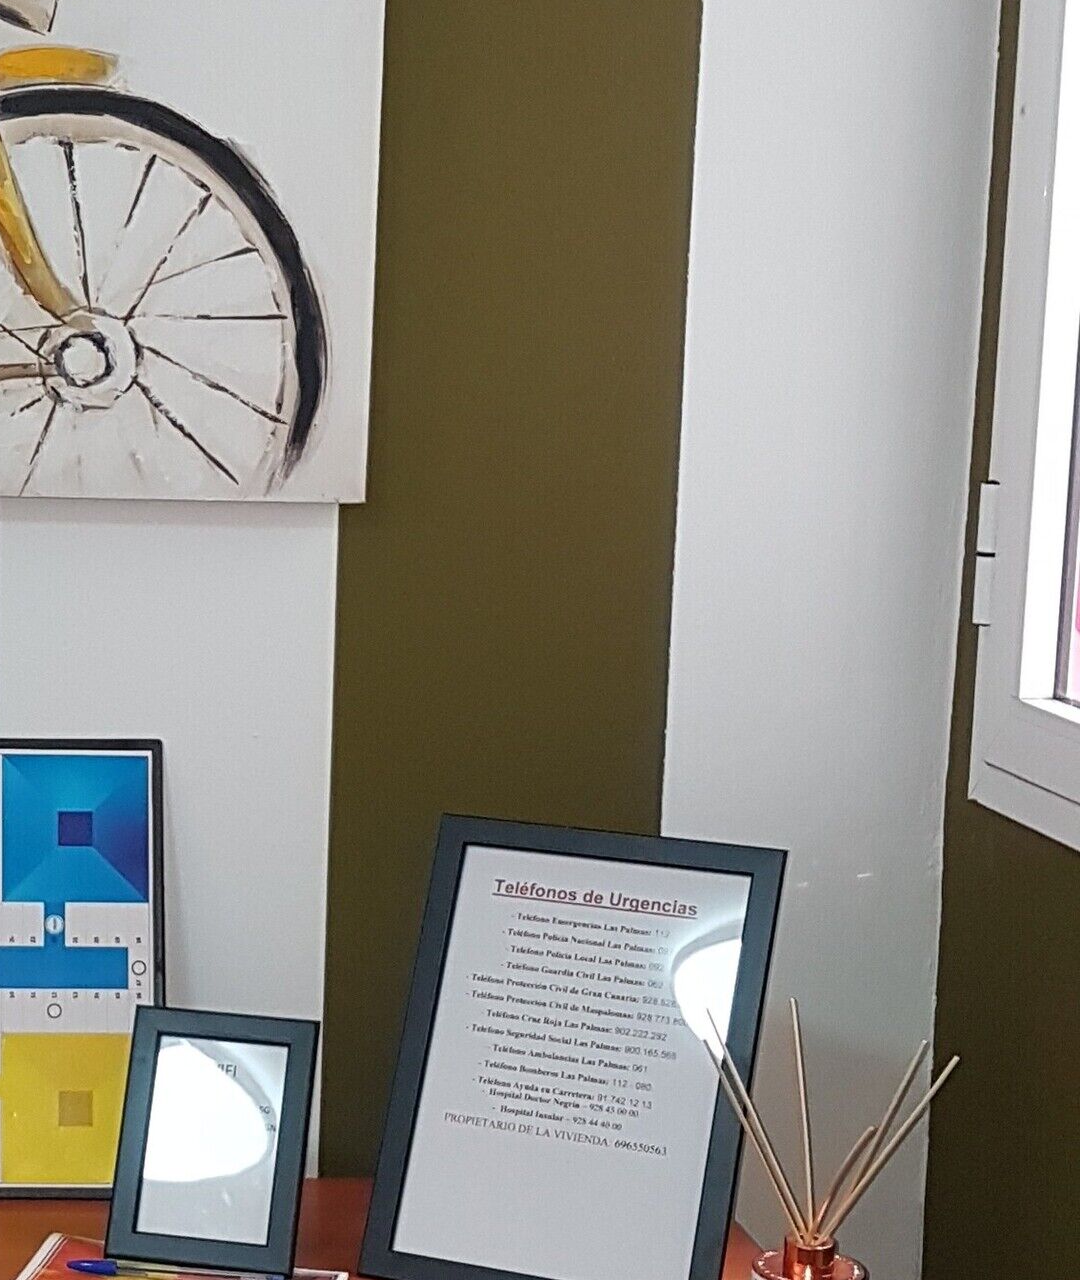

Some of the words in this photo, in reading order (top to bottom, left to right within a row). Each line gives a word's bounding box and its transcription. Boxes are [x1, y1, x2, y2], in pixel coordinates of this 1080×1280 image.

[494, 878, 577, 901] Teléfonos
[582, 889, 604, 904] de
[609, 891, 698, 916] Urgencias
[603, 923, 618, 932] Las
[607, 939, 622, 950] Las
[574, 953, 597, 964] Local
[598, 956, 613, 965] Las
[575, 970, 595, 980] Civil
[597, 972, 612, 982] Las
[548, 983, 568, 994] Civil
[569, 986, 579, 995] de
[581, 987, 603, 998] Gran
[548, 1000, 569, 1011] Civil
[569, 1004, 580, 1012] de
[542, 1016, 562, 1027] Roja
[564, 1019, 579, 1029] Las
[506, 1028, 547, 1041] Seguridad
[548, 1033, 572, 1045] Social
[573, 1037, 589, 1047] Las
[527, 1049, 580, 1063] Ambulancias
[581, 1056, 596, 1066] Las
[519, 1064, 559, 1078] Bomberos
[560, 1070, 576, 1080] Las
[612, 1078, 628, 1088] 112
[488, 1087, 523, 1100] Hospital
[524, 1093, 552, 1104] Doctor
[513, 1081, 539, 1093] Ayuda
[629, 1098, 640, 1108] 12
[500, 1104, 534, 1117] Hospital
[535, 1109, 564, 1122] Insular
[444, 1112, 516, 1132] PROPIETARIO
[517, 1123, 534, 1134] DE
[535, 1126, 551, 1138] LA
